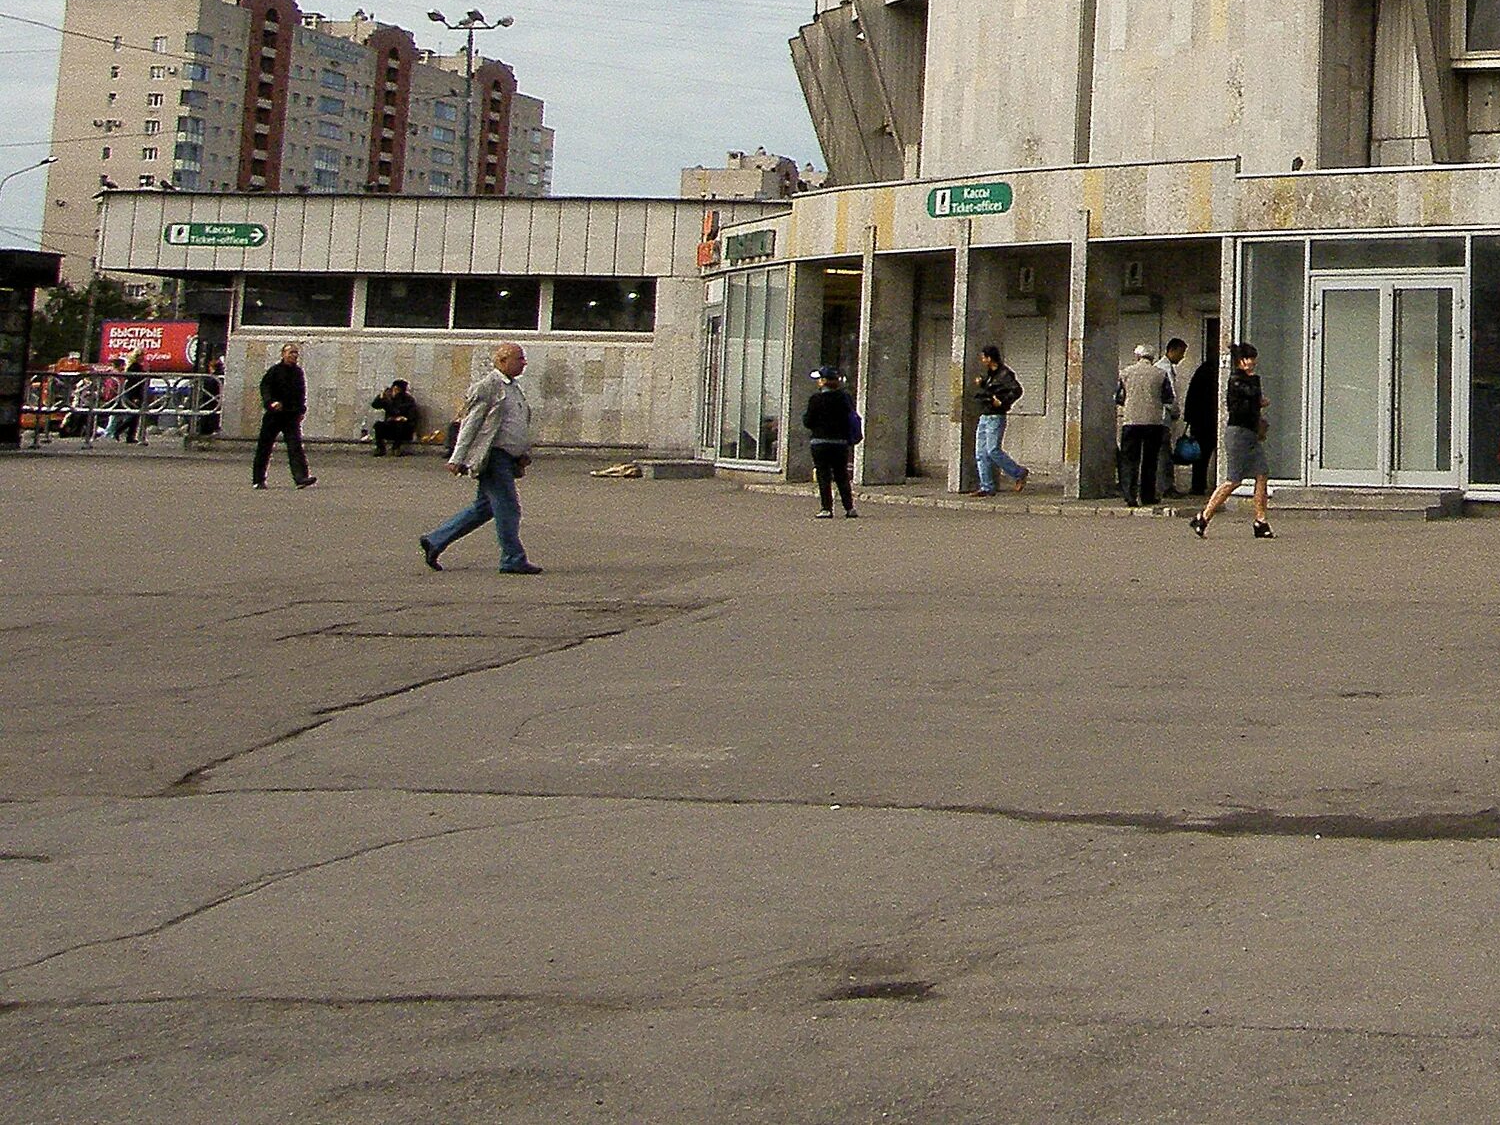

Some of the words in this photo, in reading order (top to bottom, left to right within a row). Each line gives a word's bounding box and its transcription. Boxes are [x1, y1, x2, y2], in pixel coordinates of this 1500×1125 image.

[963, 188, 990, 199] Кассы
[951, 200, 1003, 213] Ticket-offices
[109, 327, 164, 338] БЫСТРЫЕ
[108, 338, 162, 350] КРЕДИТЫ
